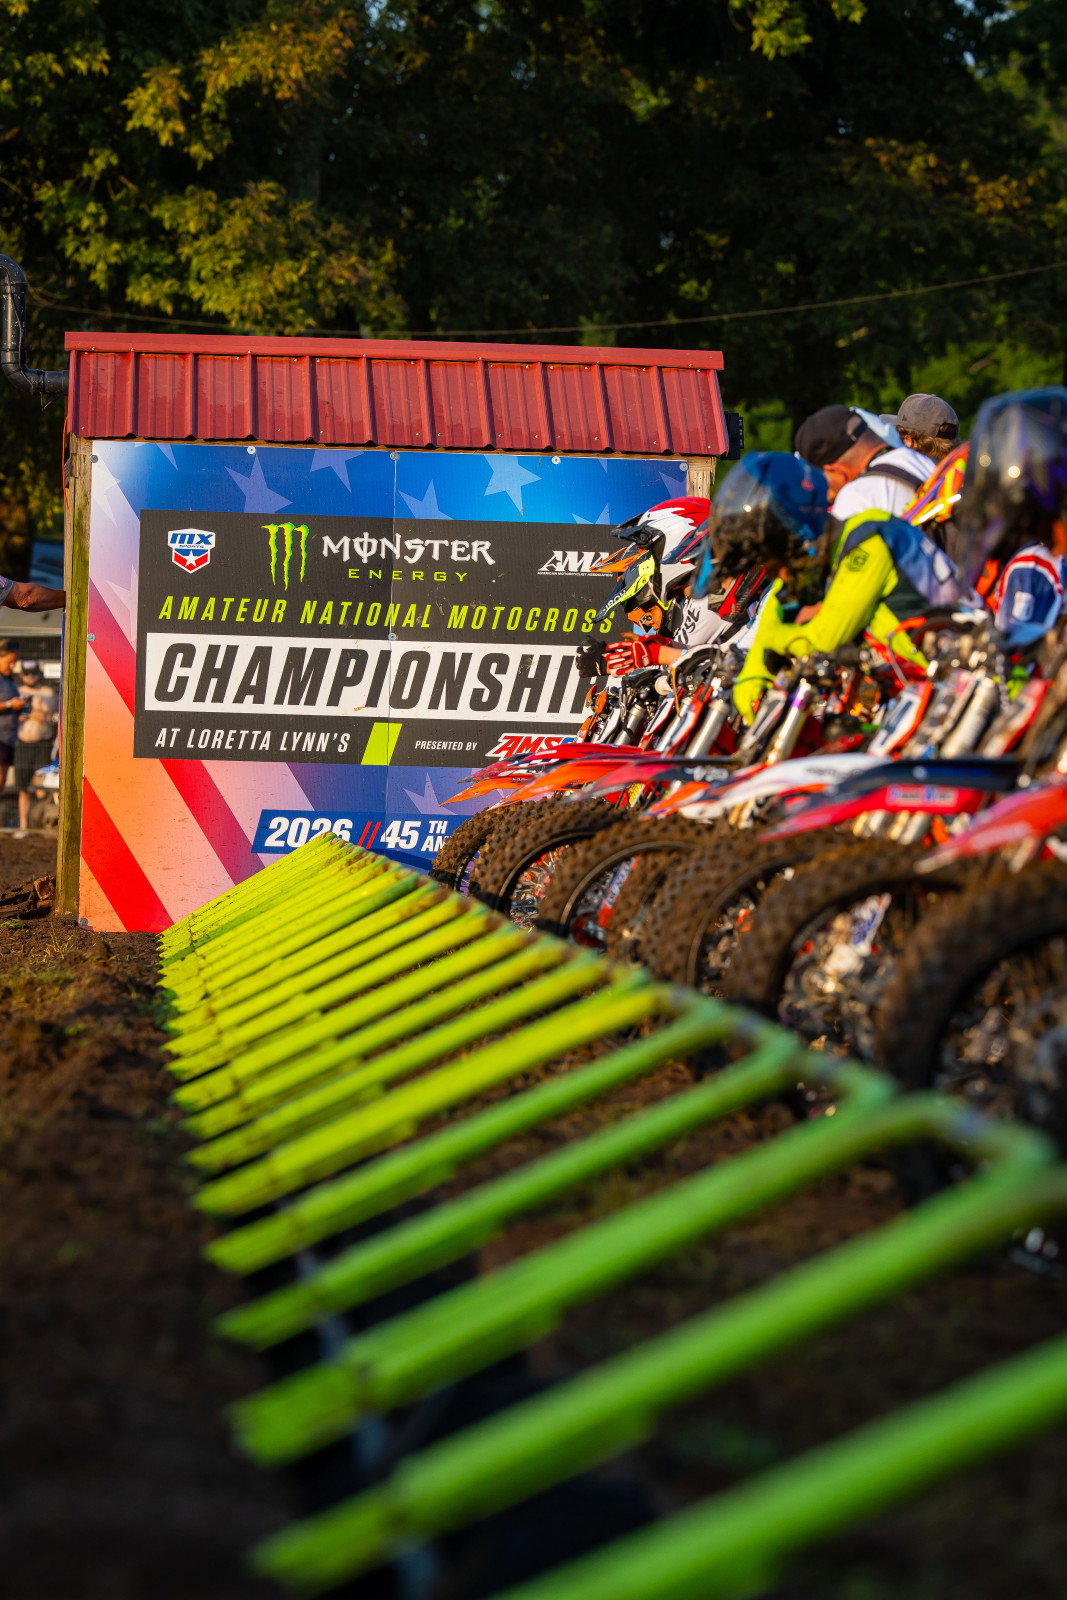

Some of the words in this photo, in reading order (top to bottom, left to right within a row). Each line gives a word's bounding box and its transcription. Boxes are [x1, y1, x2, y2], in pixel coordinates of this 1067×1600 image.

[348, 569, 468, 582] ENERGY
[158, 596, 288, 624] AMATEUR
[299, 600, 431, 628] NATIONAL
[446, 605, 615, 633] MOTOCROSS
[154, 728, 181, 748] AT
[186, 728, 272, 750] LORETTA
[279, 731, 351, 753] LYNN'S
[414, 740, 463, 751] PRESENTED
[465, 742, 478, 751] BY
[264, 816, 353, 848] 2026
[380, 820, 421, 849] 45
[428, 820, 449, 834] TH
